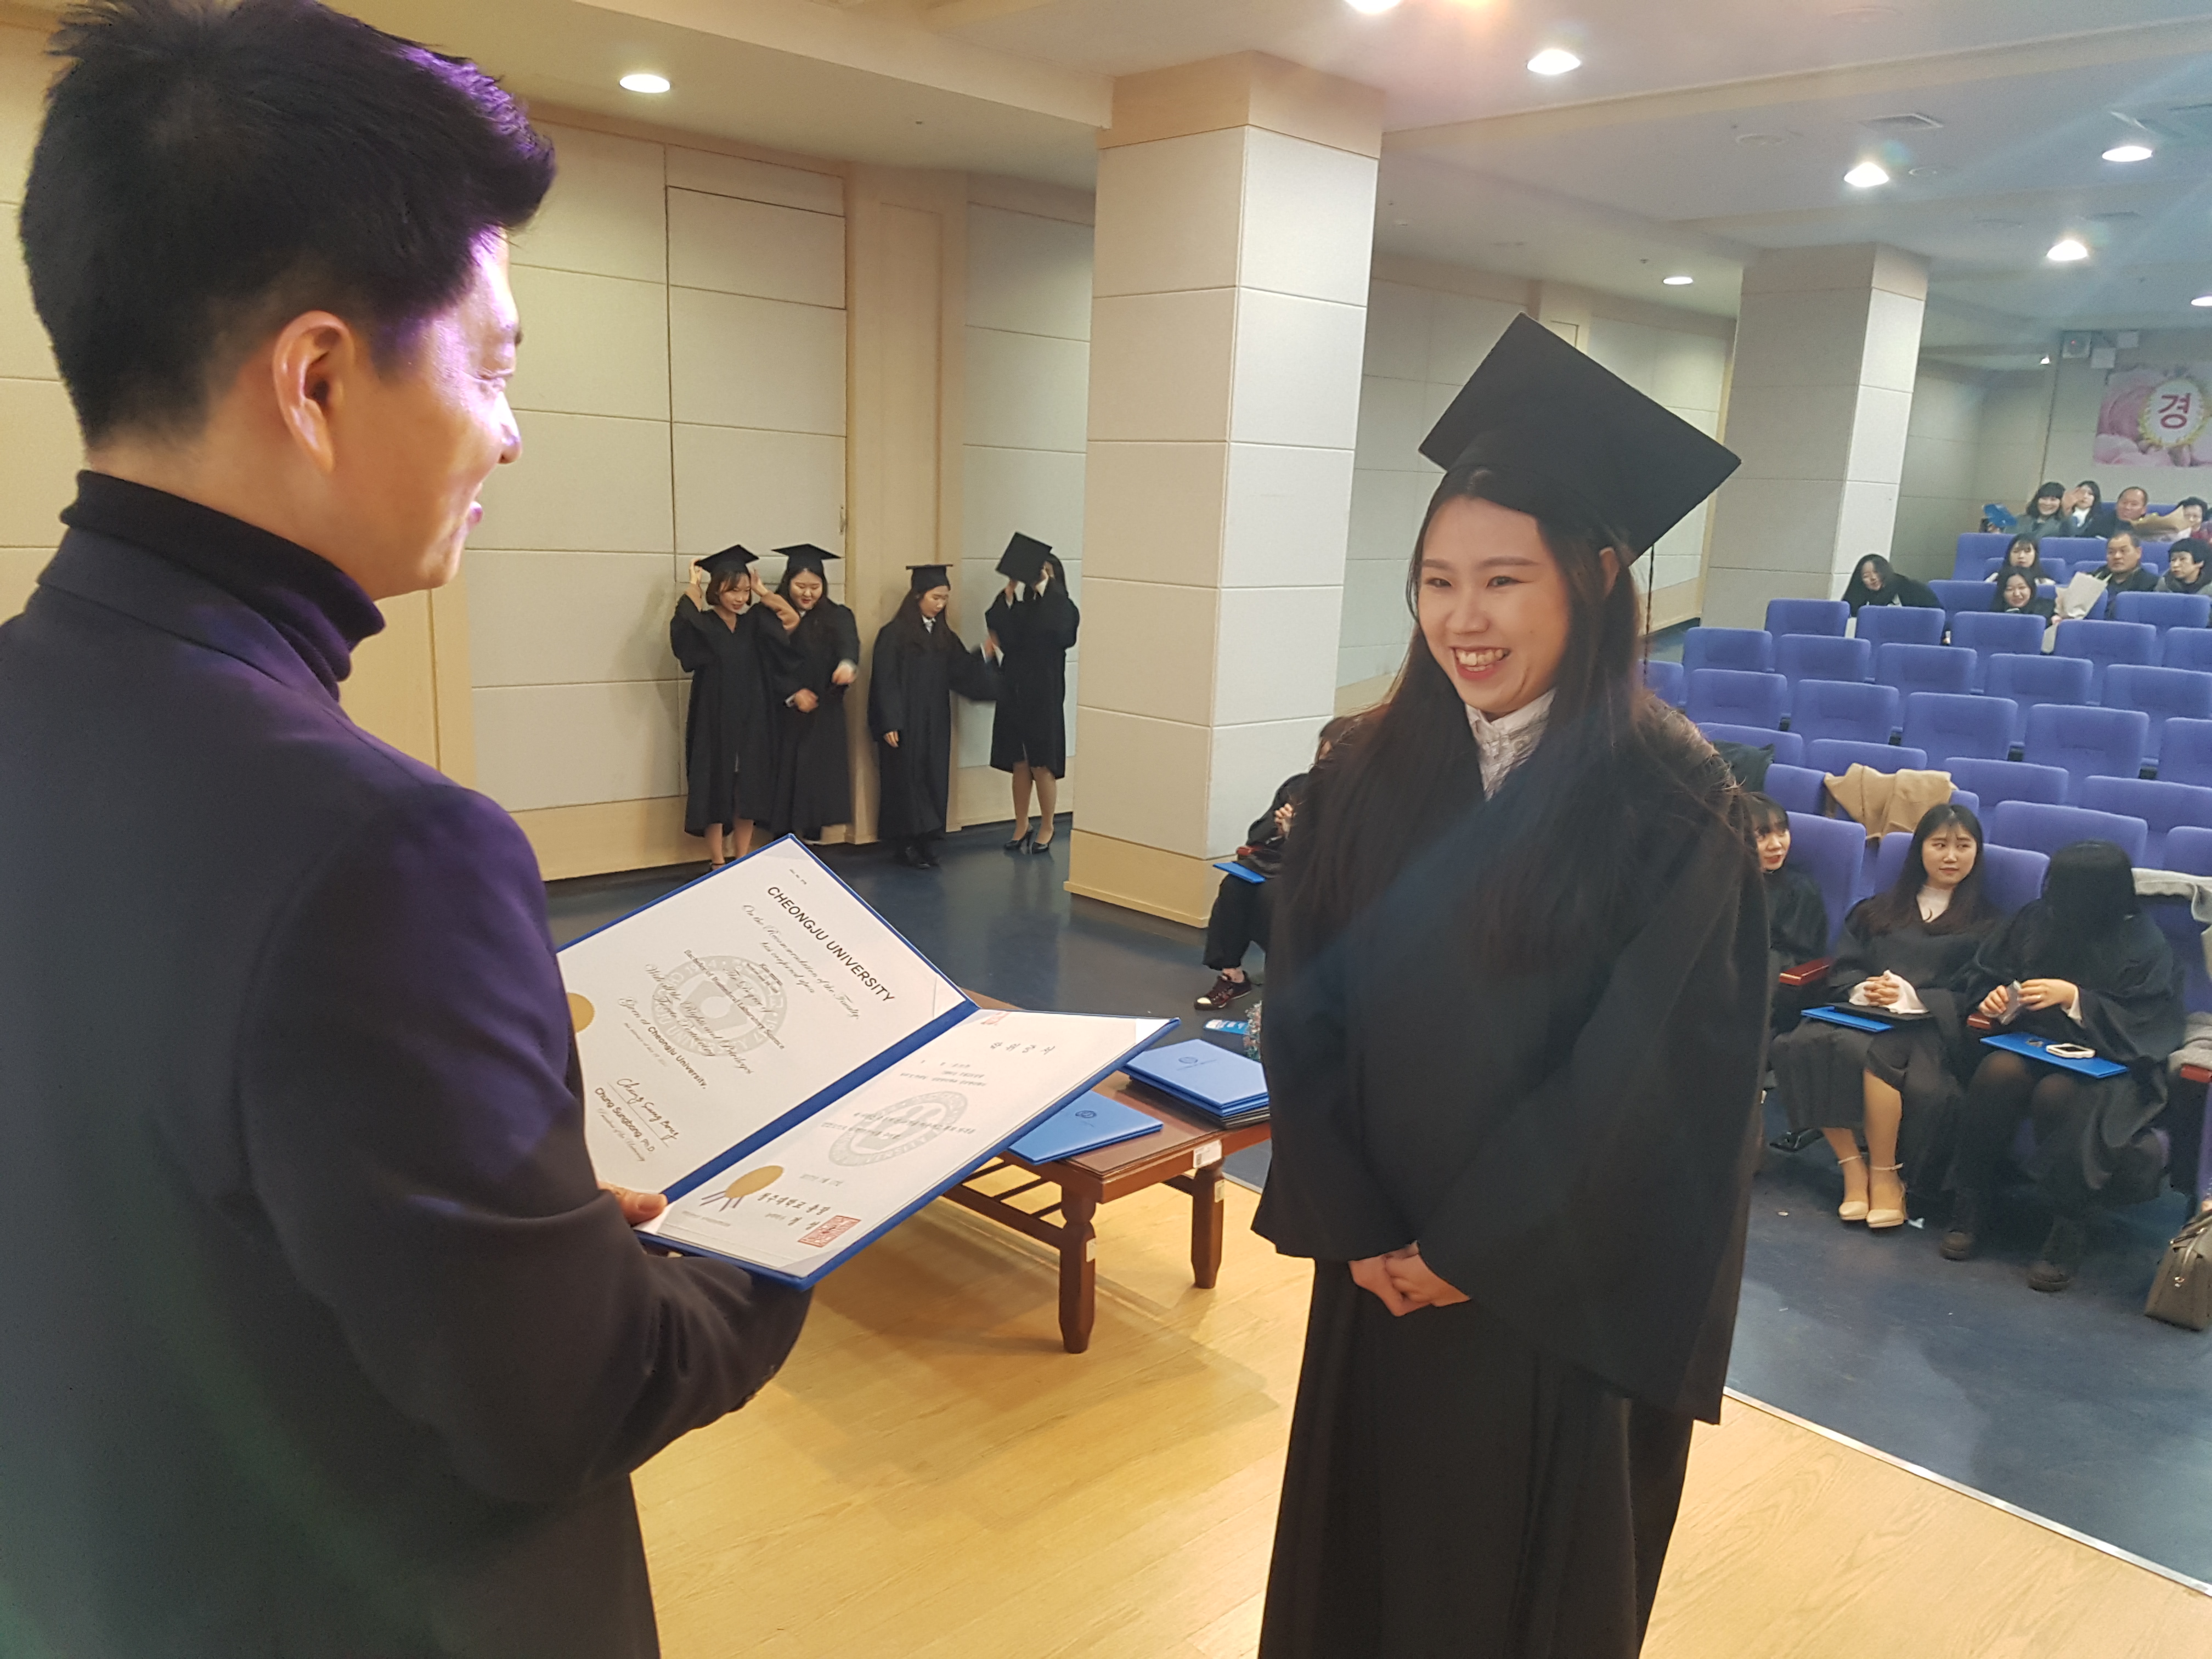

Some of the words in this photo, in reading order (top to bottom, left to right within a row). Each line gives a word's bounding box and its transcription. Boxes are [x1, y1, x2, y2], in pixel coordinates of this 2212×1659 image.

[2158, 392, 2192, 430] 경
[743, 904, 754, 917] On
[753, 916, 764, 927] the
[763, 925, 817, 978] Recommendation
[816, 978, 830, 986] of
[823, 981, 834, 993] the
[760, 941, 774, 953] has
[768, 887, 829, 940] CHEONGJU
[826, 940, 895, 1001] UNIVERSITY
[684, 949, 707, 972] Bachelor
[704, 969, 715, 978] of
[737, 1000, 765, 1030] Laboratory
[647, 1026, 678, 1056] Cheongju
[594, 1087, 615, 1109] Chung
